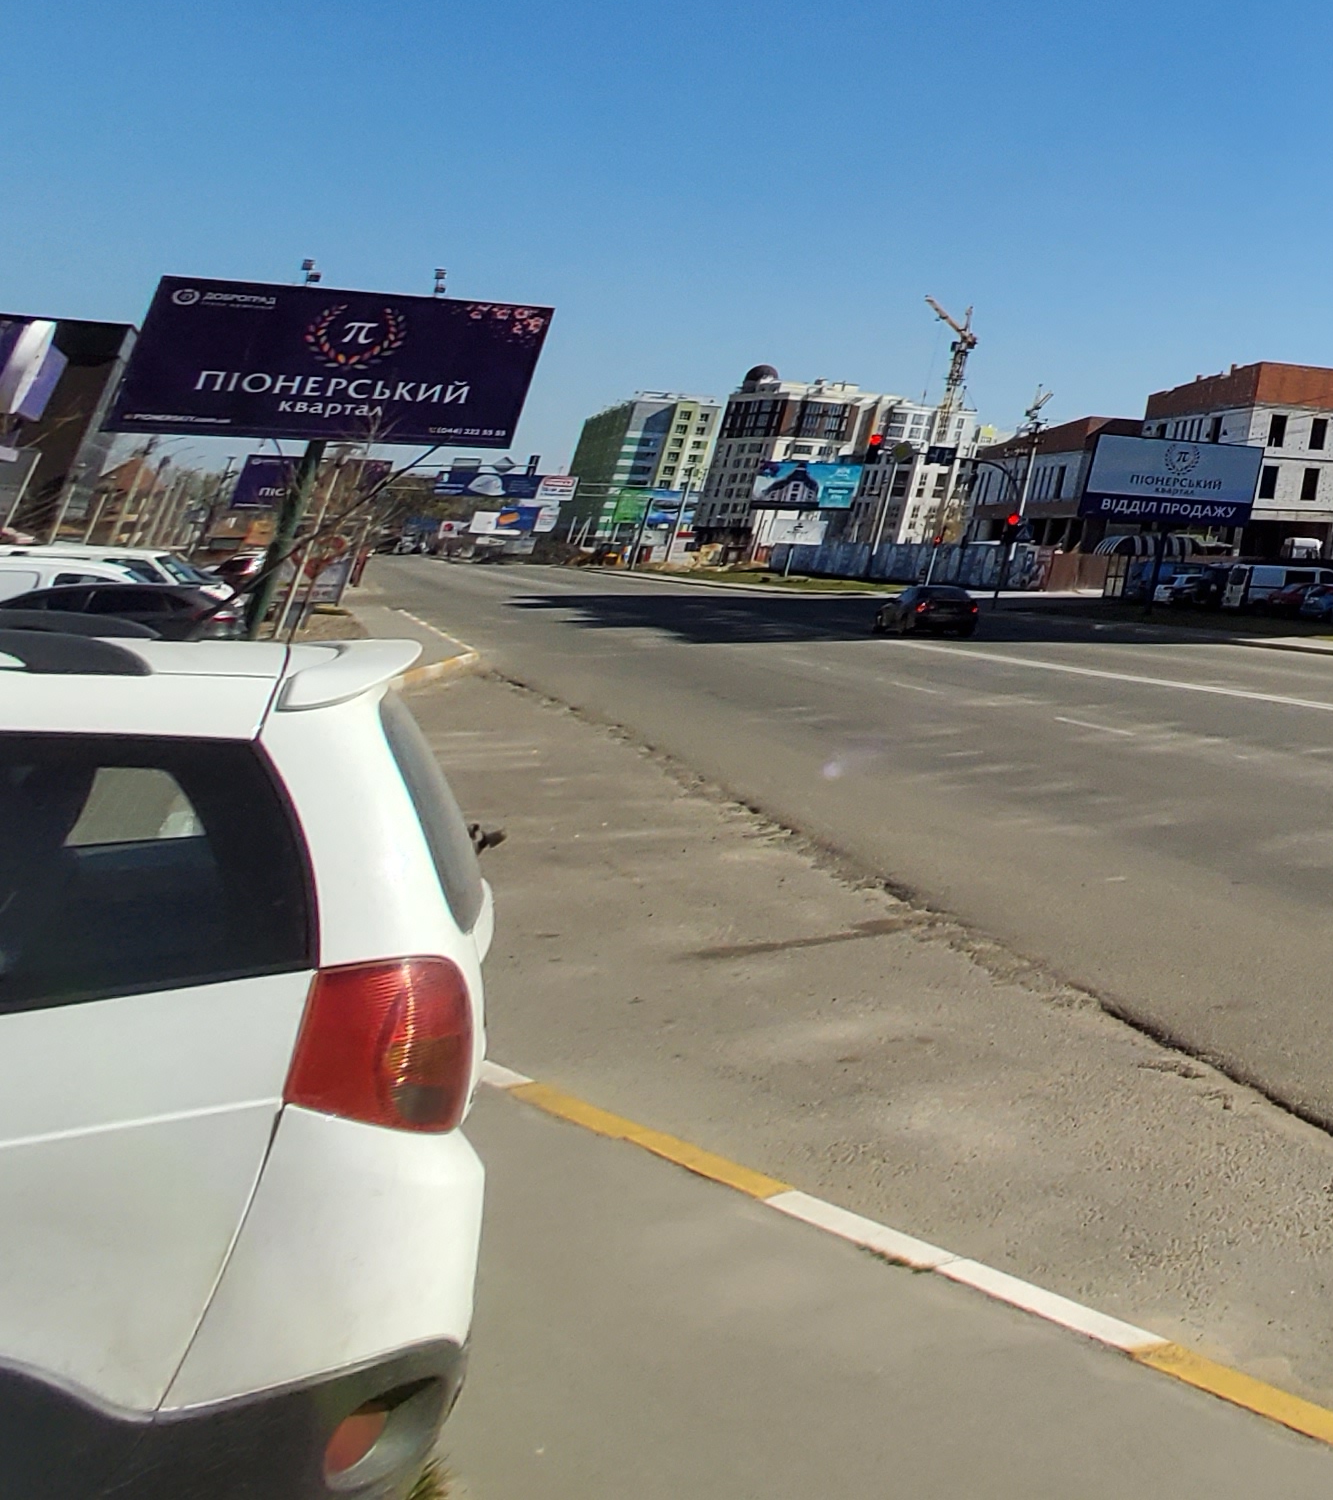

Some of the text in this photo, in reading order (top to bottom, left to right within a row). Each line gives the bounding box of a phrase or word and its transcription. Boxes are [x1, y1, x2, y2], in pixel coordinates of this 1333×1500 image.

[194, 371, 470, 405] ПІОНЕРСЬКИЙ
[277, 400, 383, 418] квартал
[1129, 474, 1222, 491] ПІОНЕРСЬКИЙ
[1101, 498, 1236, 519] ВІДДІЛ ПРОДАЖУ
